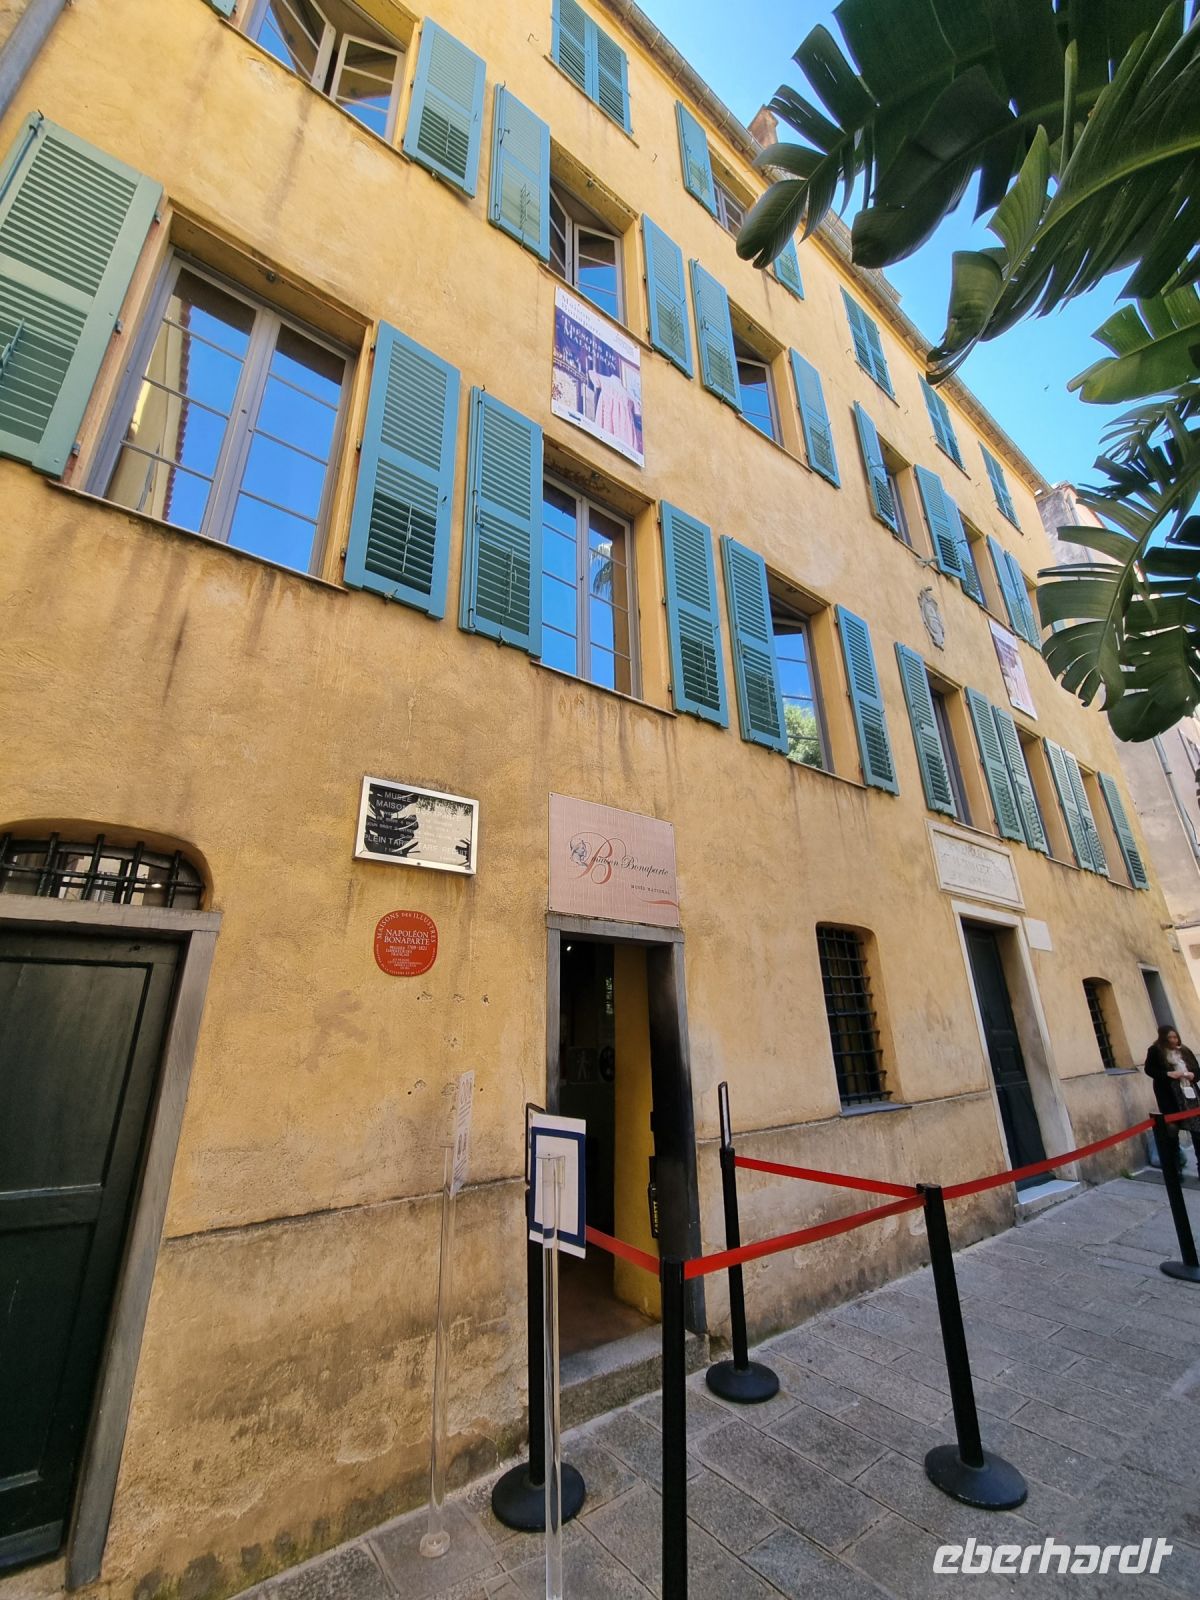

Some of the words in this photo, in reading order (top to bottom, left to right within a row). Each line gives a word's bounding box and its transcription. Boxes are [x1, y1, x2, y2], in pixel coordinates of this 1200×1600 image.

[563, 326, 617, 371] MALMAISON
[621, 855, 669, 878] Bonaparte
[647, 887, 671, 895] NATIONAL
[376, 912, 400, 940] MAISONS
[413, 912, 437, 943] ILLUSTRES
[385, 929, 429, 939] NAPOLÉON
[384, 935, 430, 946] BONAPARTE
